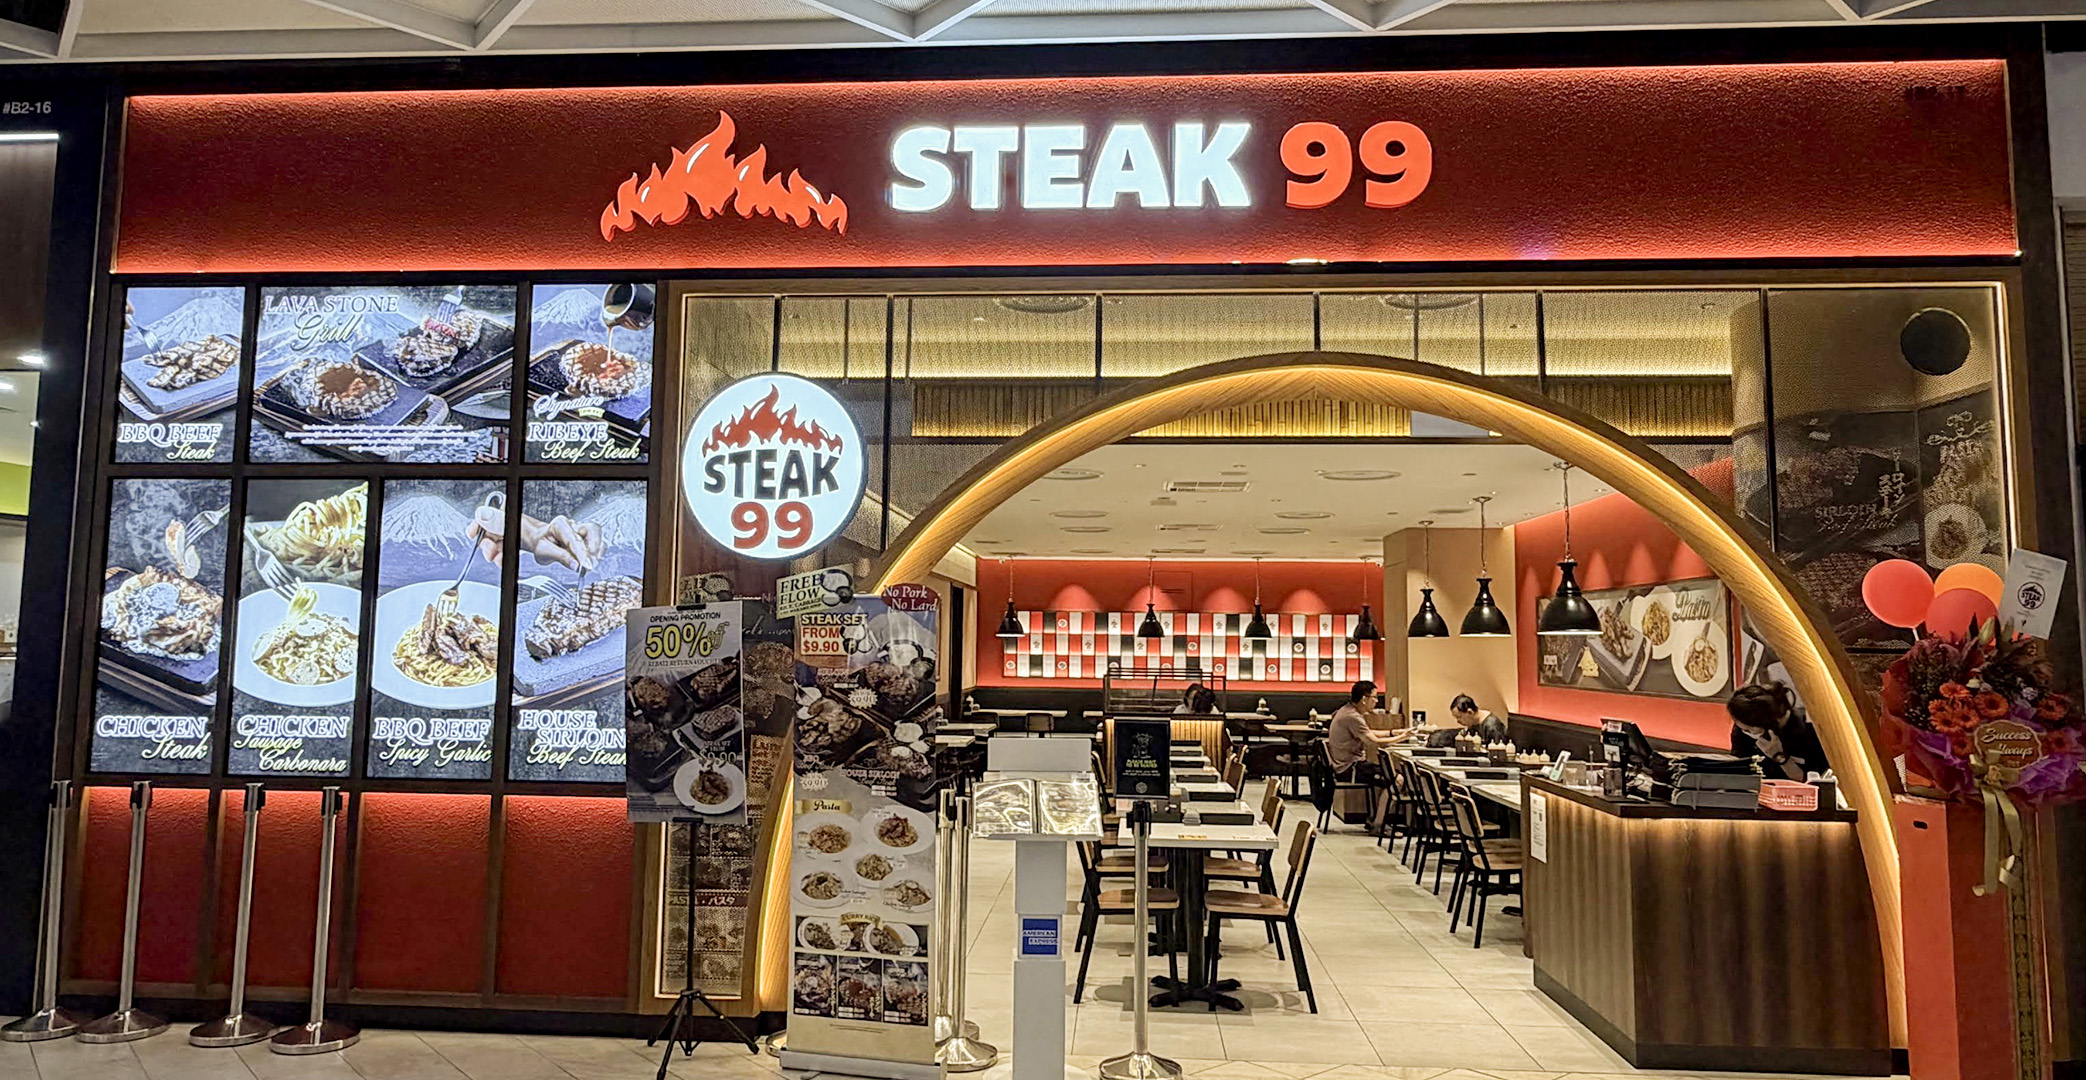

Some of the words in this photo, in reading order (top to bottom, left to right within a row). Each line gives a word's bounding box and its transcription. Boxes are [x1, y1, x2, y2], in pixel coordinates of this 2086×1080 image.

[2, 101, 52, 114] #B2-16
[889, 121, 1252, 211] STEAK
[1279, 120, 1434, 209] 99
[264, 295, 319, 315] LAVA
[323, 295, 400, 314] STONE
[290, 313, 362, 351] Grill
[533, 391, 604, 420] Signature
[117, 423, 172, 448] BBQ
[168, 423, 223, 443] BEEF
[526, 421, 608, 441] RIBEYE
[166, 438, 217, 460] Steak
[541, 440, 592, 464] Beef
[590, 438, 642, 460] Steak
[703, 448, 840, 500] STEAK
[731, 501, 813, 549] 99
[780, 573, 821, 593] FREE
[883, 585, 899, 598] No
[902, 585, 928, 598] Pork
[780, 587, 820, 605] FLOW
[892, 598, 908, 610] No
[911, 598, 938, 611] Lard
[1672, 589, 1711, 621] Pasta
[650, 615, 679, 623] OPENING
[681, 612, 721, 621] PROMOTION
[801, 613, 842, 626] STEAK
[843, 613, 868, 626] SET
[645, 622, 712, 660] 50%
[802, 627, 840, 638] FROM
[803, 640, 839, 653] $9.90
[96, 715, 208, 738] CHICKEN
[236, 715, 350, 738] CHICKEN
[518, 709, 598, 730] HOUSE
[233, 728, 303, 756] Sausage
[372, 718, 433, 746] BBQ
[429, 718, 492, 741] BEEF
[535, 728, 626, 750] SIRLOIN
[1982, 728, 2032, 743] Success
[142, 731, 212, 761] Steak
[379, 739, 430, 767] Spicy
[434, 739, 493, 768] Garlic
[527, 743, 579, 770] Beef
[257, 748, 348, 772] Carbonara
[813, 800, 841, 811] Pasta
